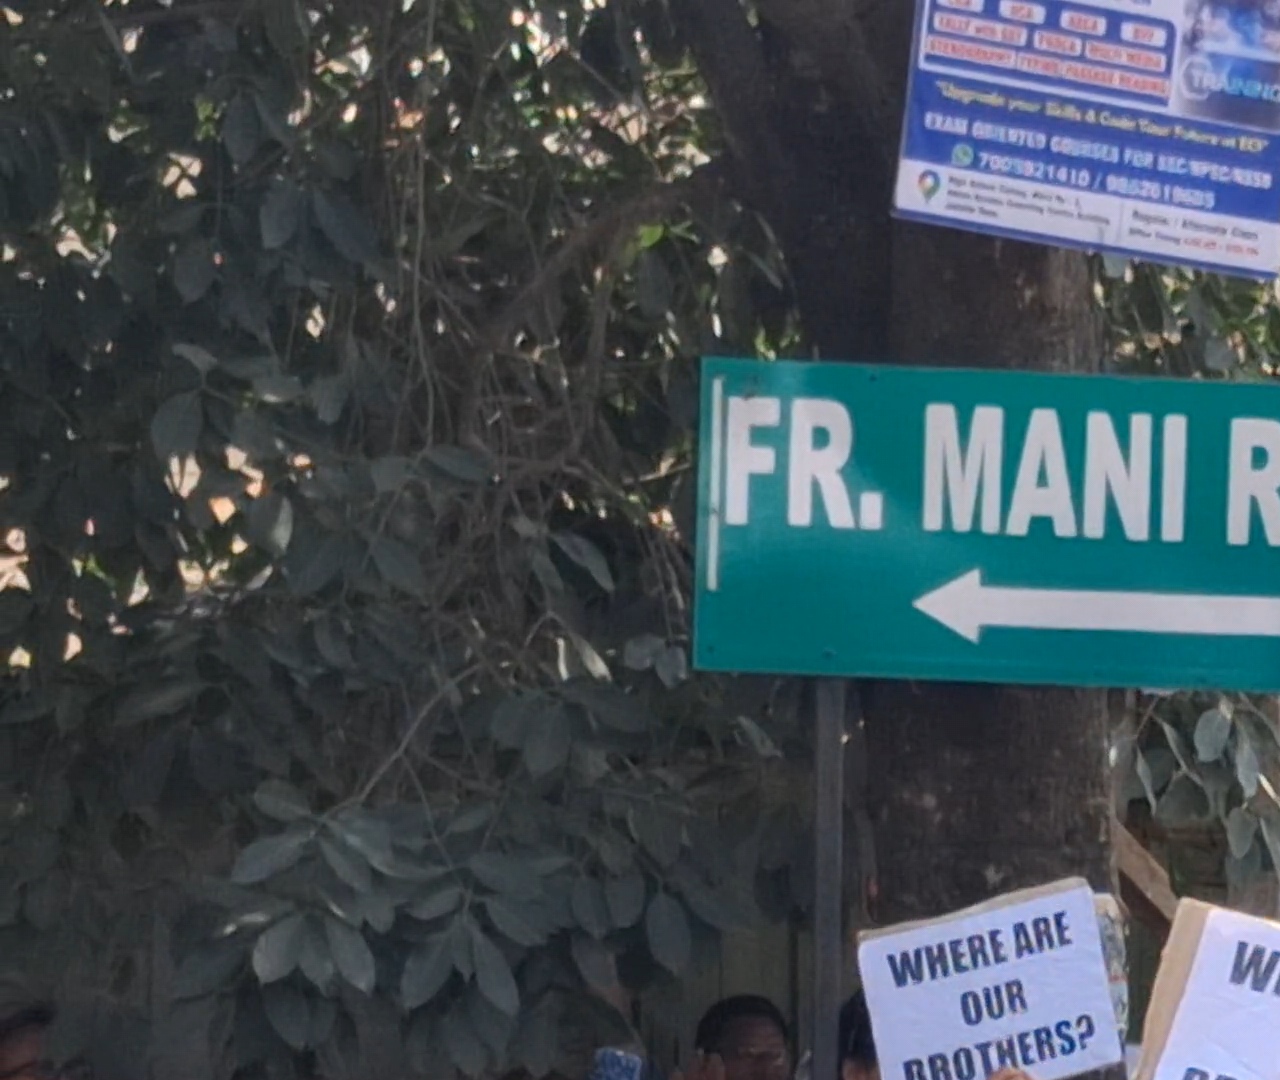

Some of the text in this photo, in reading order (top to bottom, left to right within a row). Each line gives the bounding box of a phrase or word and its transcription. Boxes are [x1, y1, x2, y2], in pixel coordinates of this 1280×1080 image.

[724, 396, 884, 531] FR.
[922, 403, 1188, 543] MANI
[886, 911, 1074, 989] WHERE ARE
[959, 978, 1029, 1026] OUR
